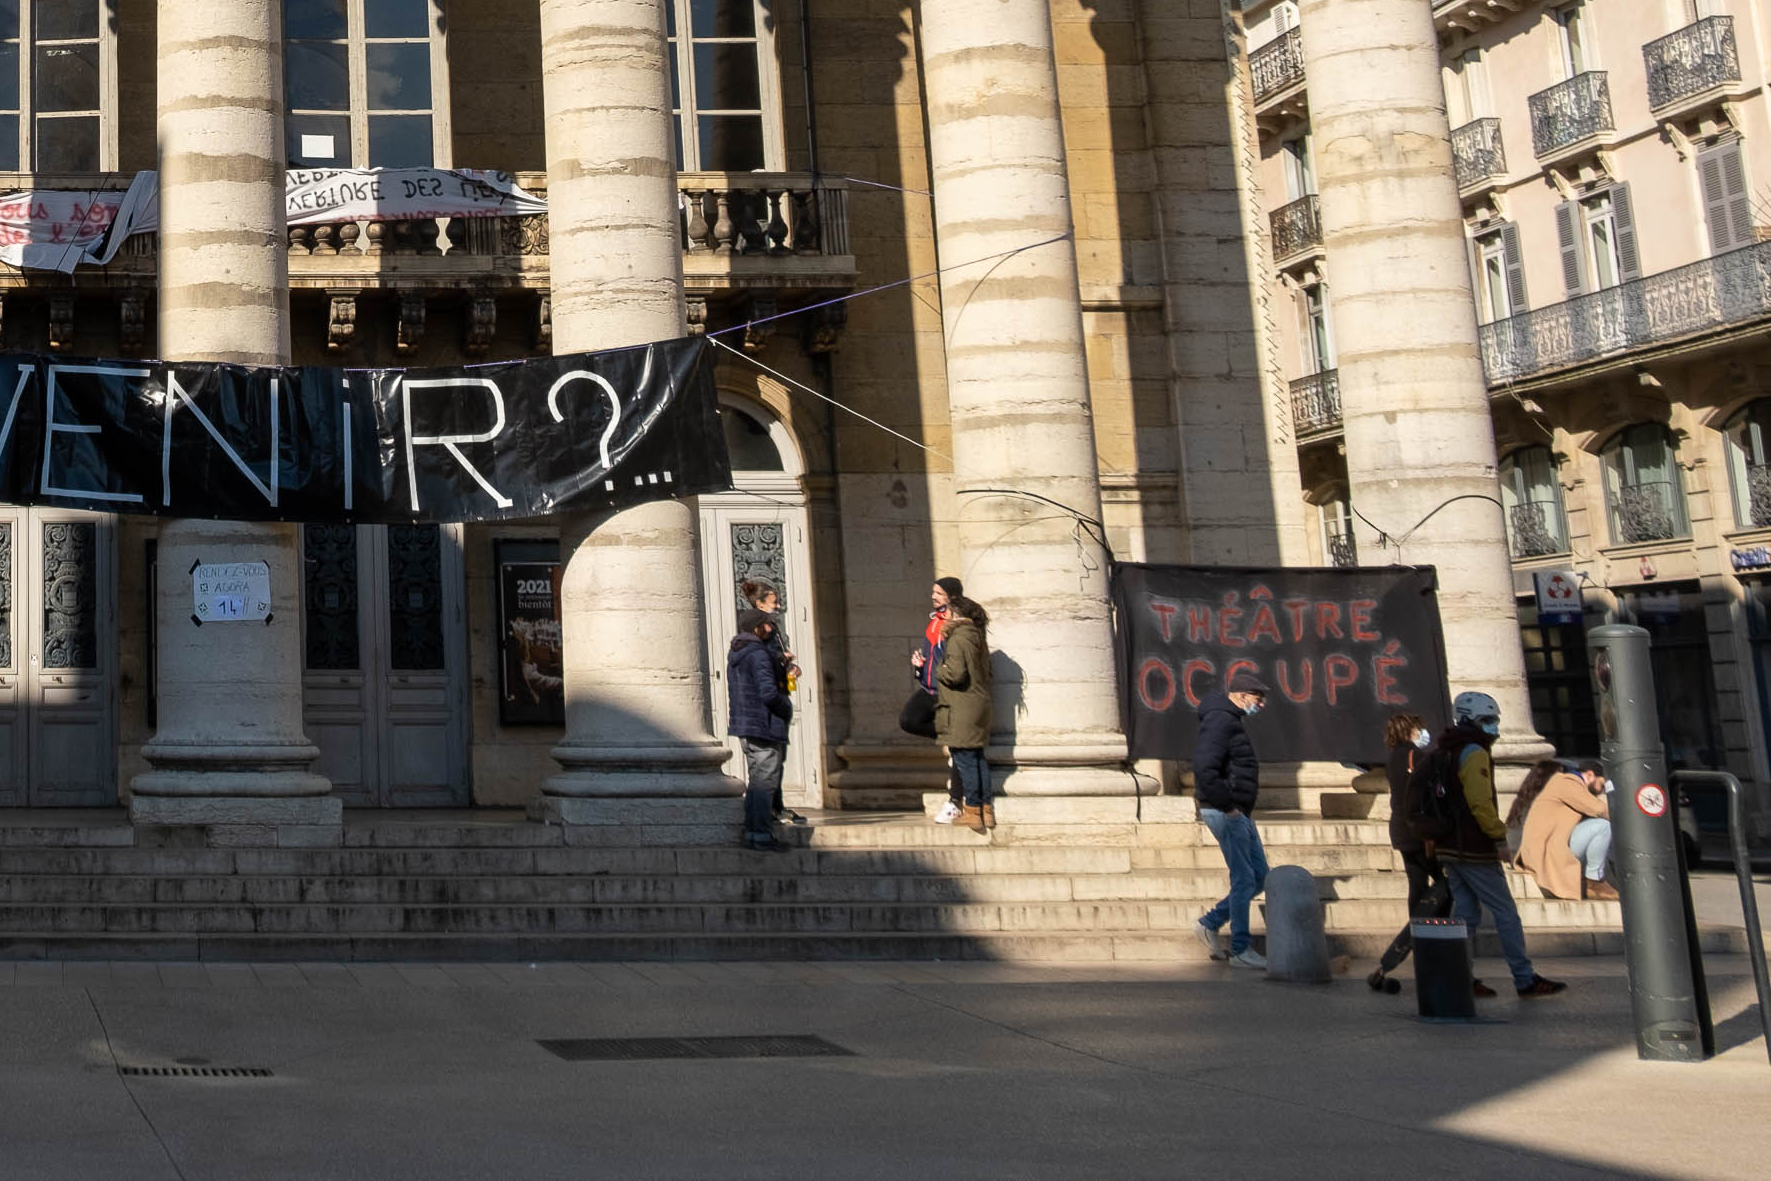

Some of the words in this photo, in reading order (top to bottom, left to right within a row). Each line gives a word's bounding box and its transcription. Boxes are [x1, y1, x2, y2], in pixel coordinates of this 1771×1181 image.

[517, 579, 552, 594] 2021
[518, 598, 552, 609] bientôt
[1149, 585, 1381, 647] THÉÂTRE
